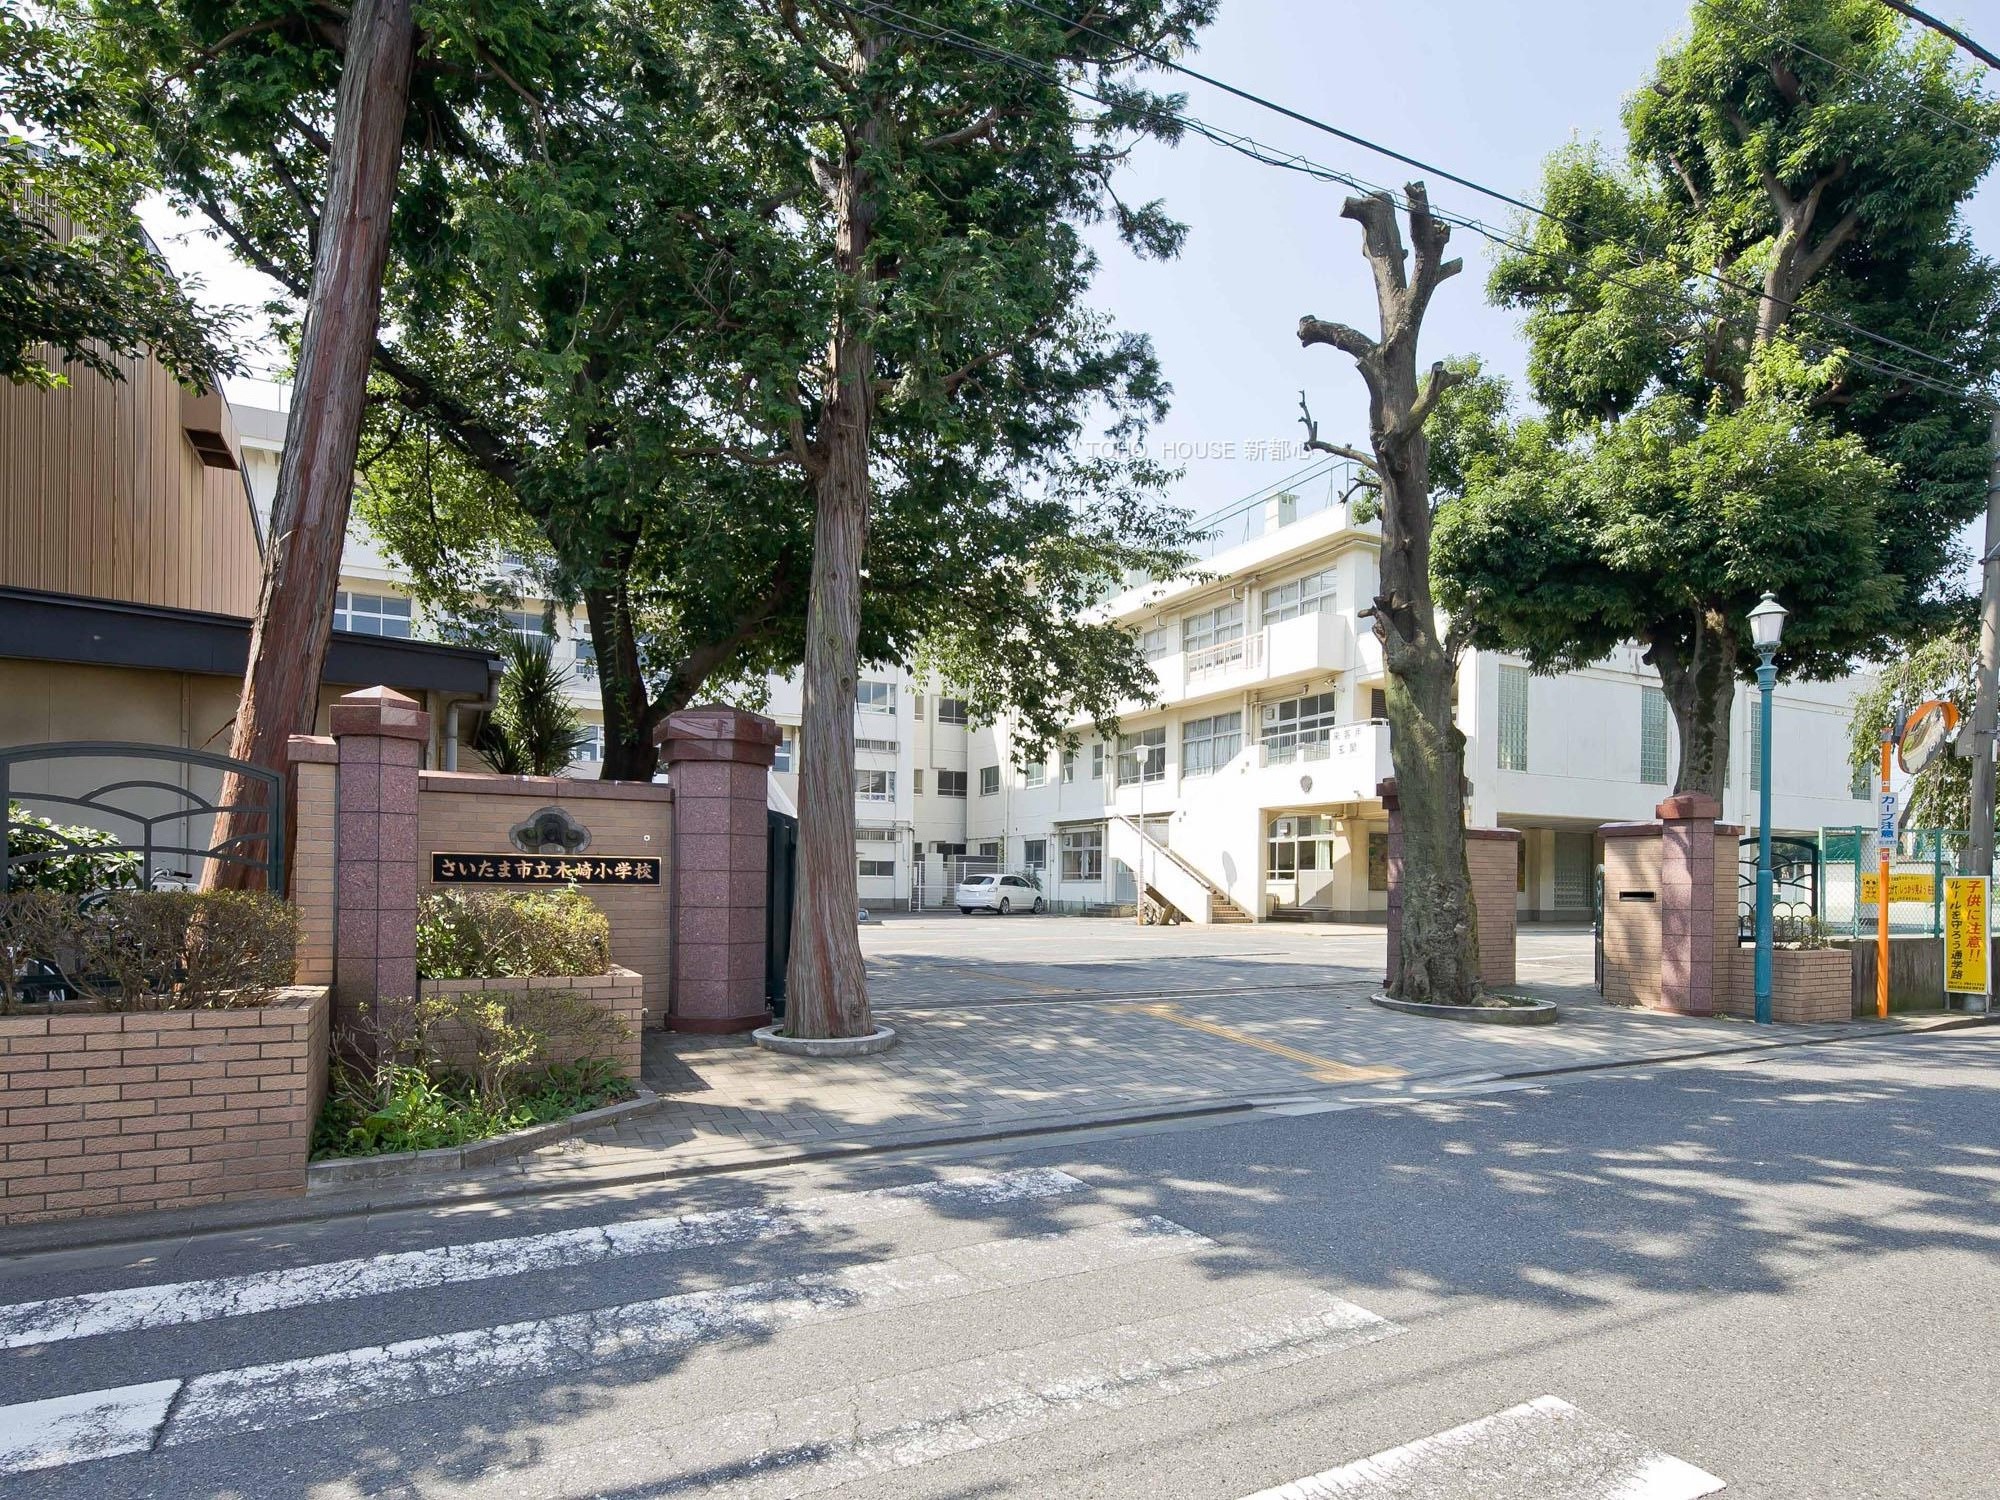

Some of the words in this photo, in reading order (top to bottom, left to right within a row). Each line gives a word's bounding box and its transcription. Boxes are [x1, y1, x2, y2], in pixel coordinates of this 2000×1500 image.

[1880, 795, 1896, 838] カーブ注意
[441, 859, 653, 880] さいたま市立木崎小学校
[1950, 881, 1964, 980] ルールを守ろう通学路
